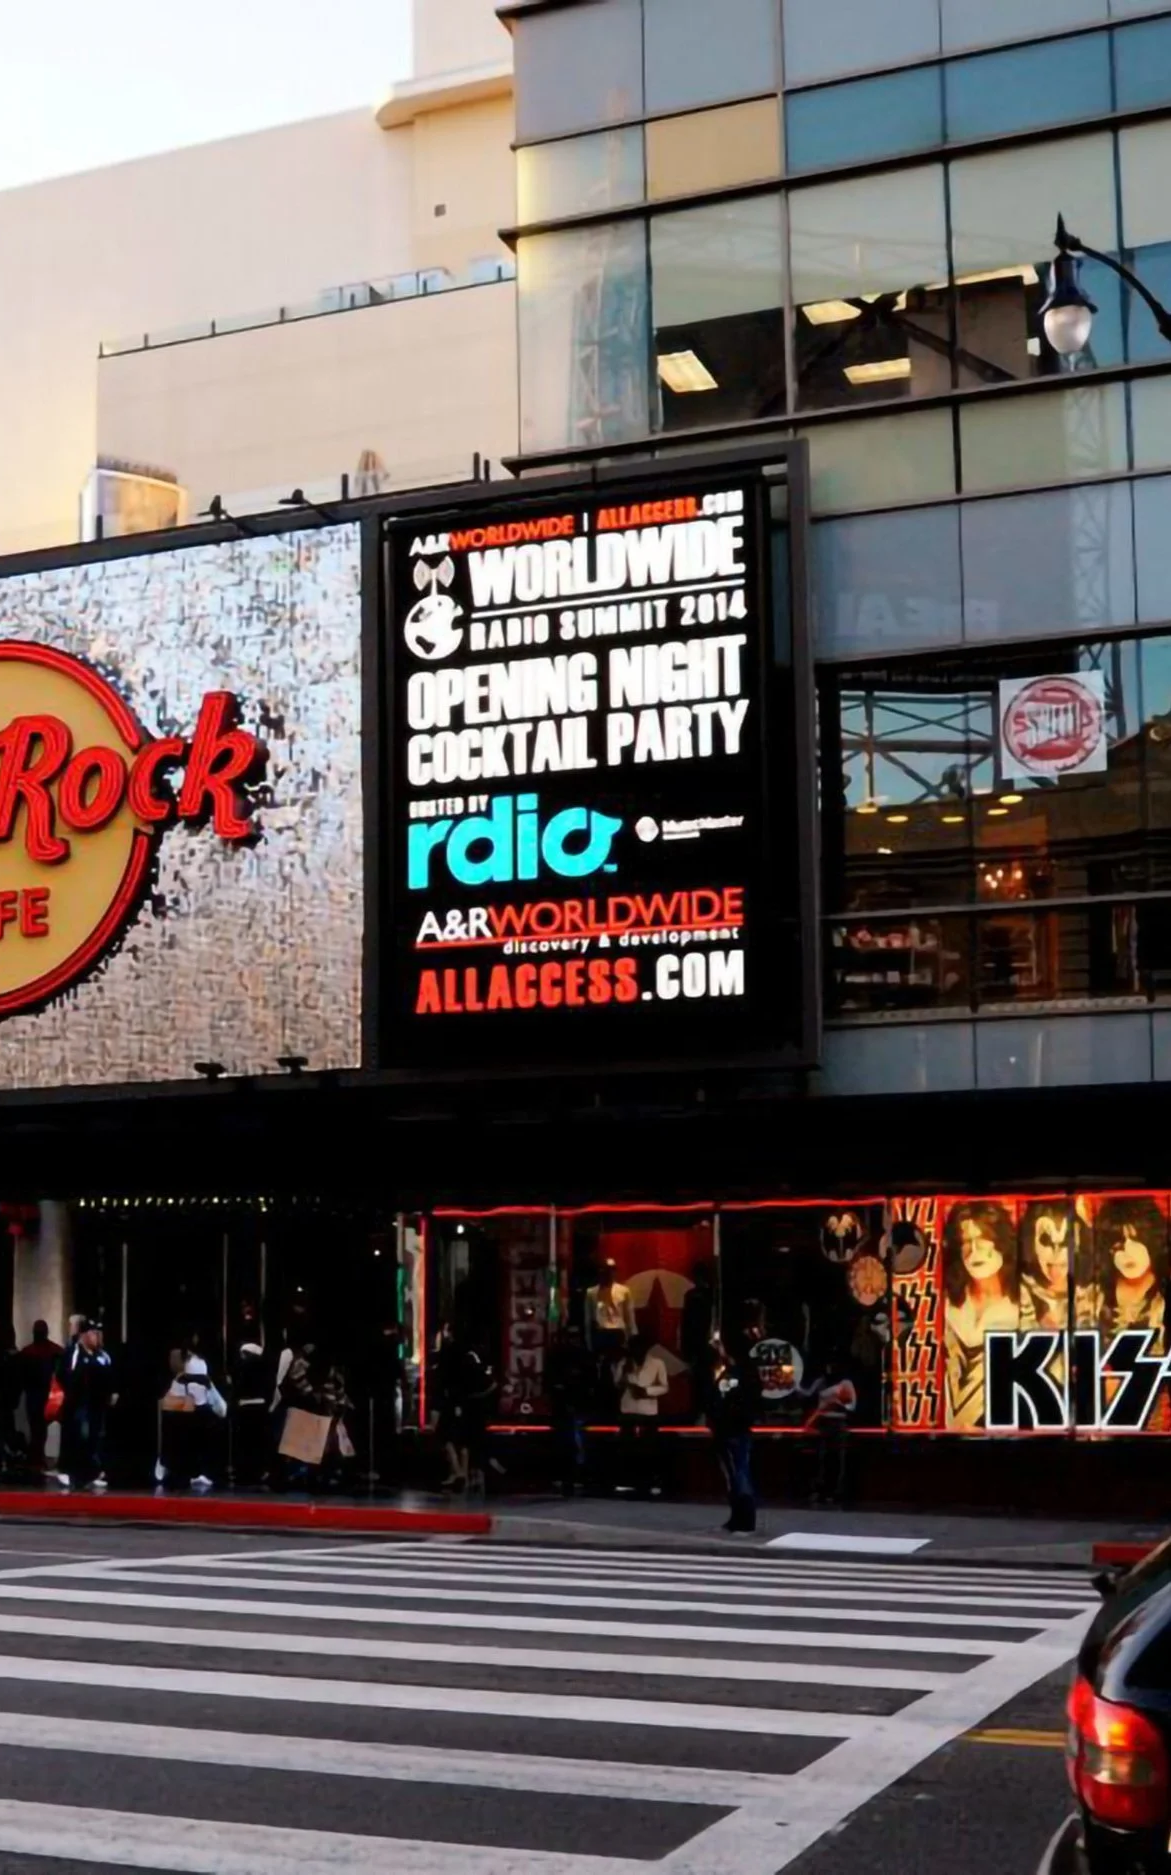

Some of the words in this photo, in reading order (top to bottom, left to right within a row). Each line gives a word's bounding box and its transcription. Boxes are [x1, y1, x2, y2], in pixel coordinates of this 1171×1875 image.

[467, 515, 747, 607] WORLDWIDE
[469, 613, 550, 651] RADIO
[559, 599, 668, 641] SUMMIT
[680, 588, 748, 626] 2014
[407, 651, 598, 730] OPENING
[608, 633, 748, 709] NIGHT
[407, 717, 597, 786] COCKTAIL
[606, 698, 750, 766] PARTY
[408, 793, 622, 890] rdio
[415, 949, 745, 1014] ALLACCESS.COM
[503, 936, 590, 954] discovery
[618, 926, 740, 947] development
[984, 1330, 1171, 1430] KIS
